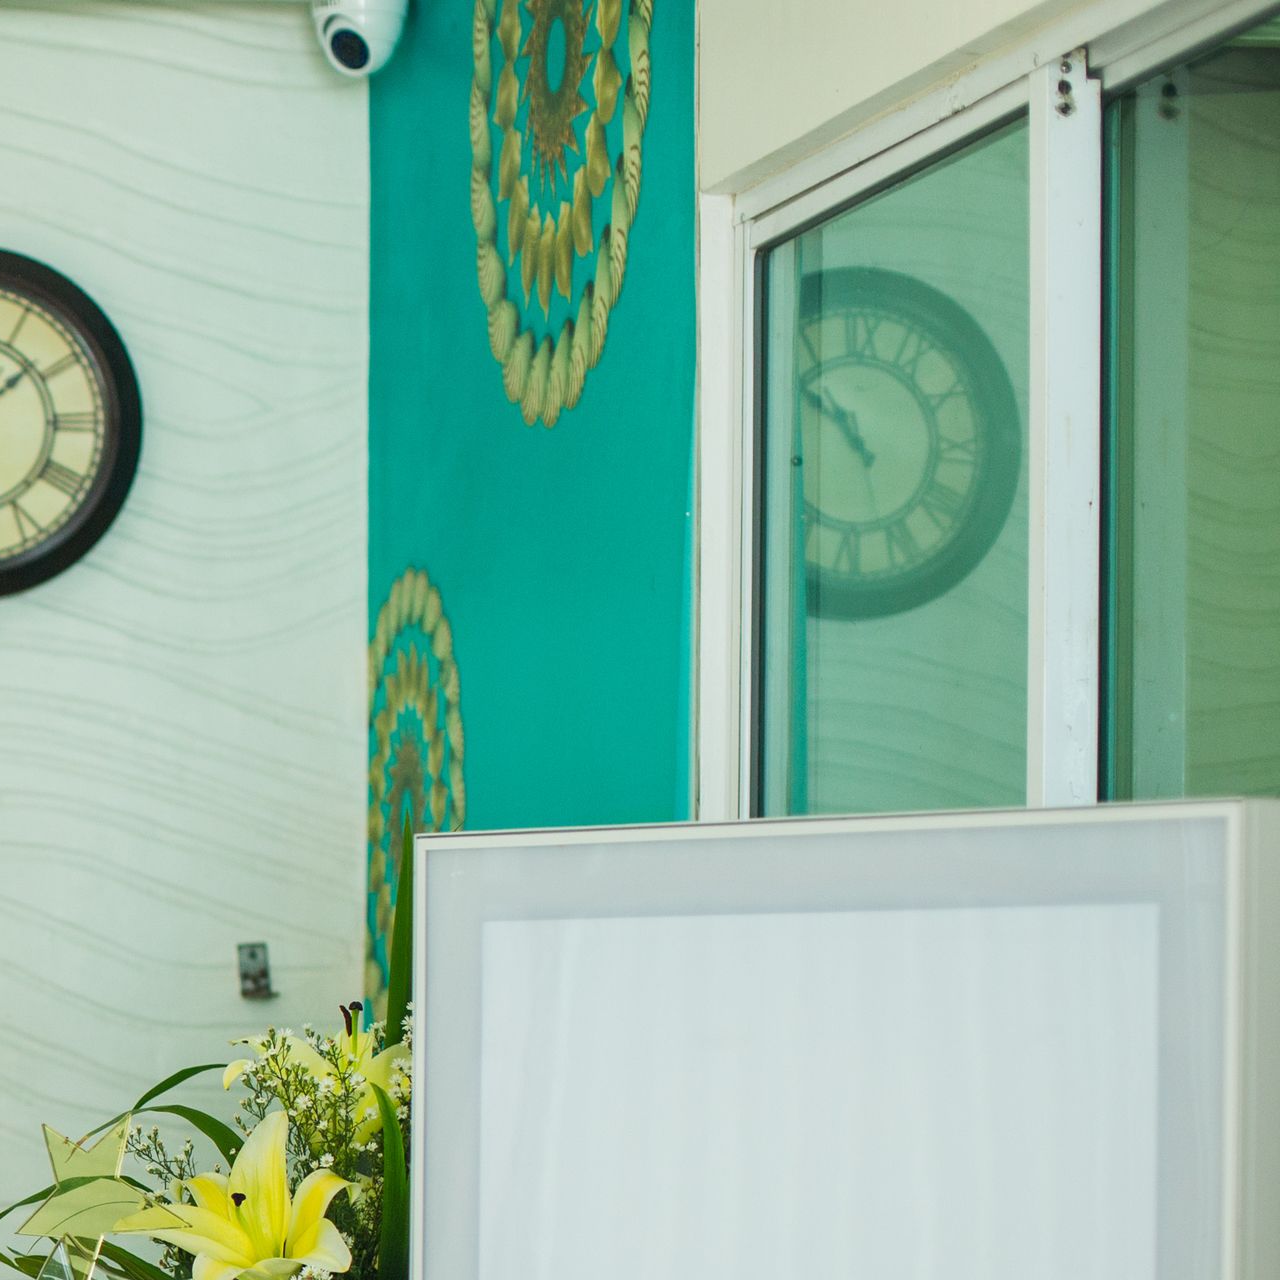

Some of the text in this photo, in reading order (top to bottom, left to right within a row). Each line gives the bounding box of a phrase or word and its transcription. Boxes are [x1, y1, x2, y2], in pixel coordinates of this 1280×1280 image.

[7, 307, 30, 347] I
[41, 350, 83, 380] II
[54, 412, 97, 432] III
[12, 501, 45, 541] V
